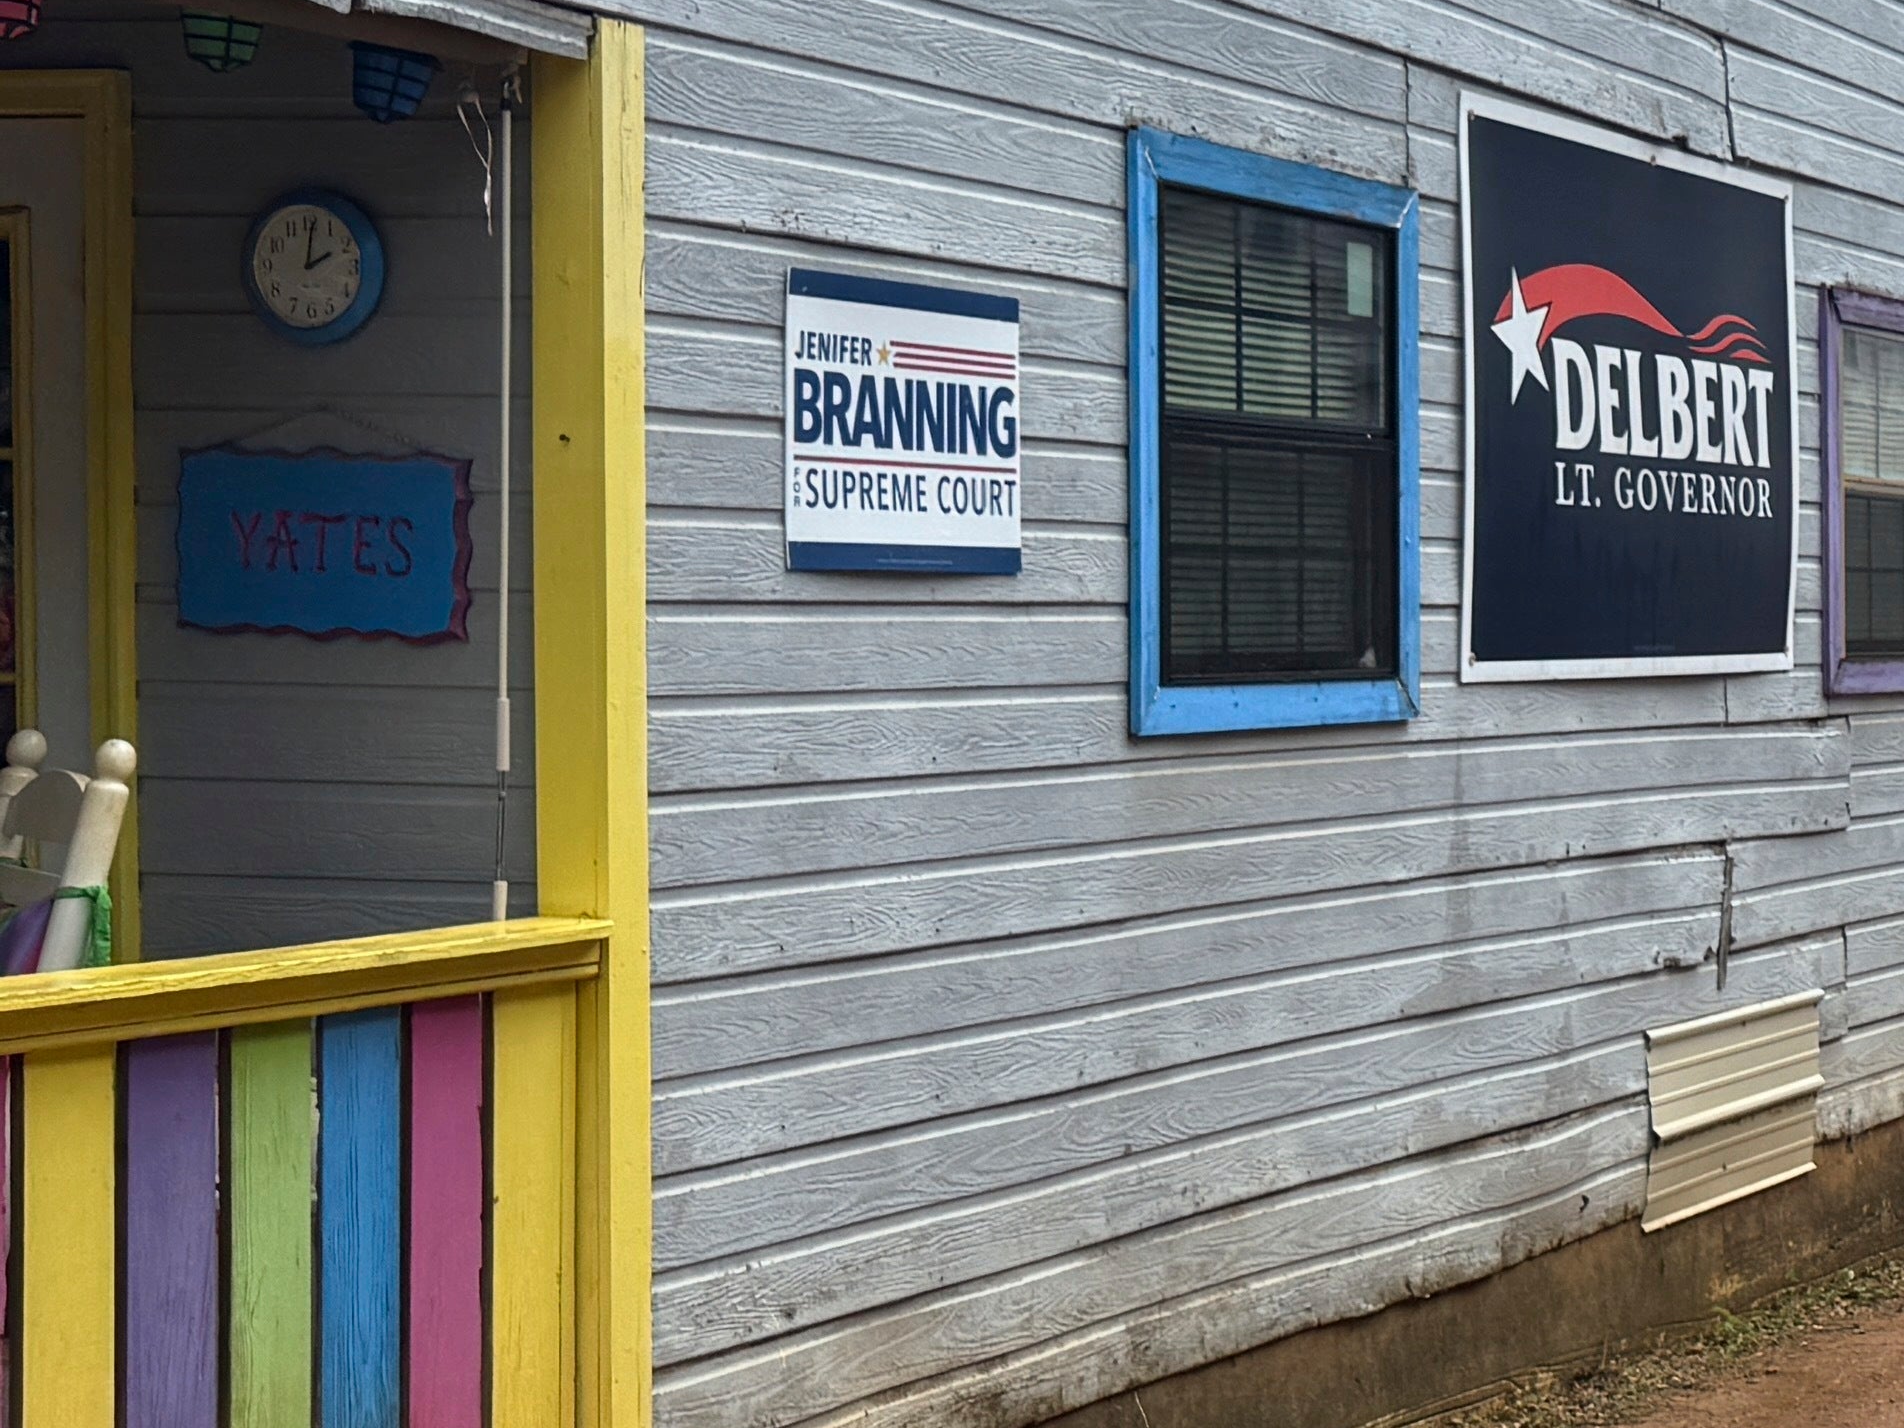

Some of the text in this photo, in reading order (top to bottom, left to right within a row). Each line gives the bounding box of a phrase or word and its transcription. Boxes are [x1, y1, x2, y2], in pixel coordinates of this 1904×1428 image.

[795, 330, 873, 366] JENIFER
[794, 368, 1017, 459] BRANNING
[1552, 337, 1774, 469] DELBERT
[805, 468, 1017, 517] SUPREME COURT
[1555, 462, 1774, 519] LT. GOVERNOR
[228, 509, 414, 578] YATES
